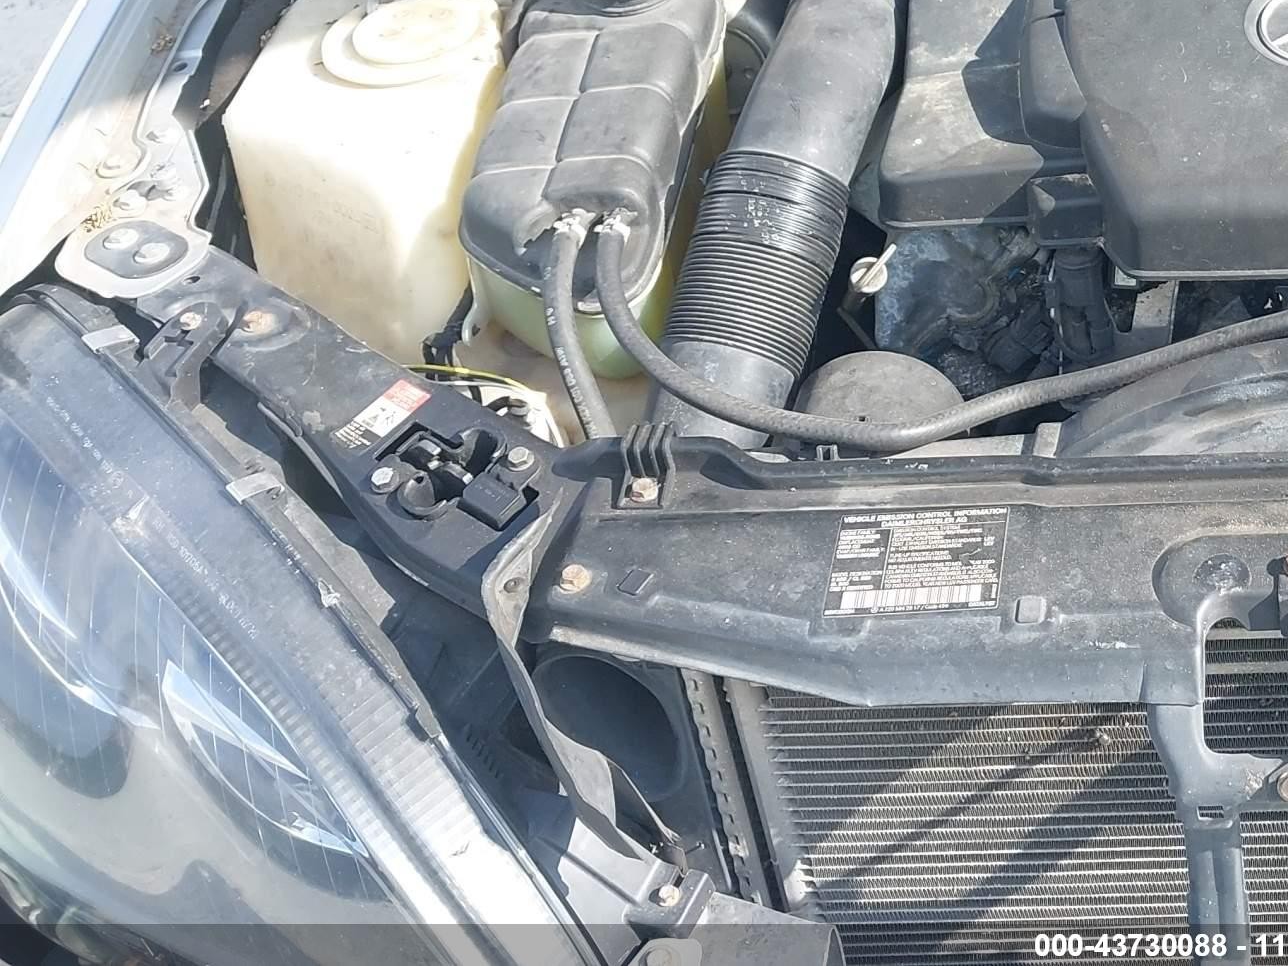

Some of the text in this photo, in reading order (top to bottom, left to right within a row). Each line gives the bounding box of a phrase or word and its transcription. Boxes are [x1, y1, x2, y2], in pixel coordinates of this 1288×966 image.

[844, 508, 1007, 524] VEHICLE EMISSION CONTROL INFORMATION
